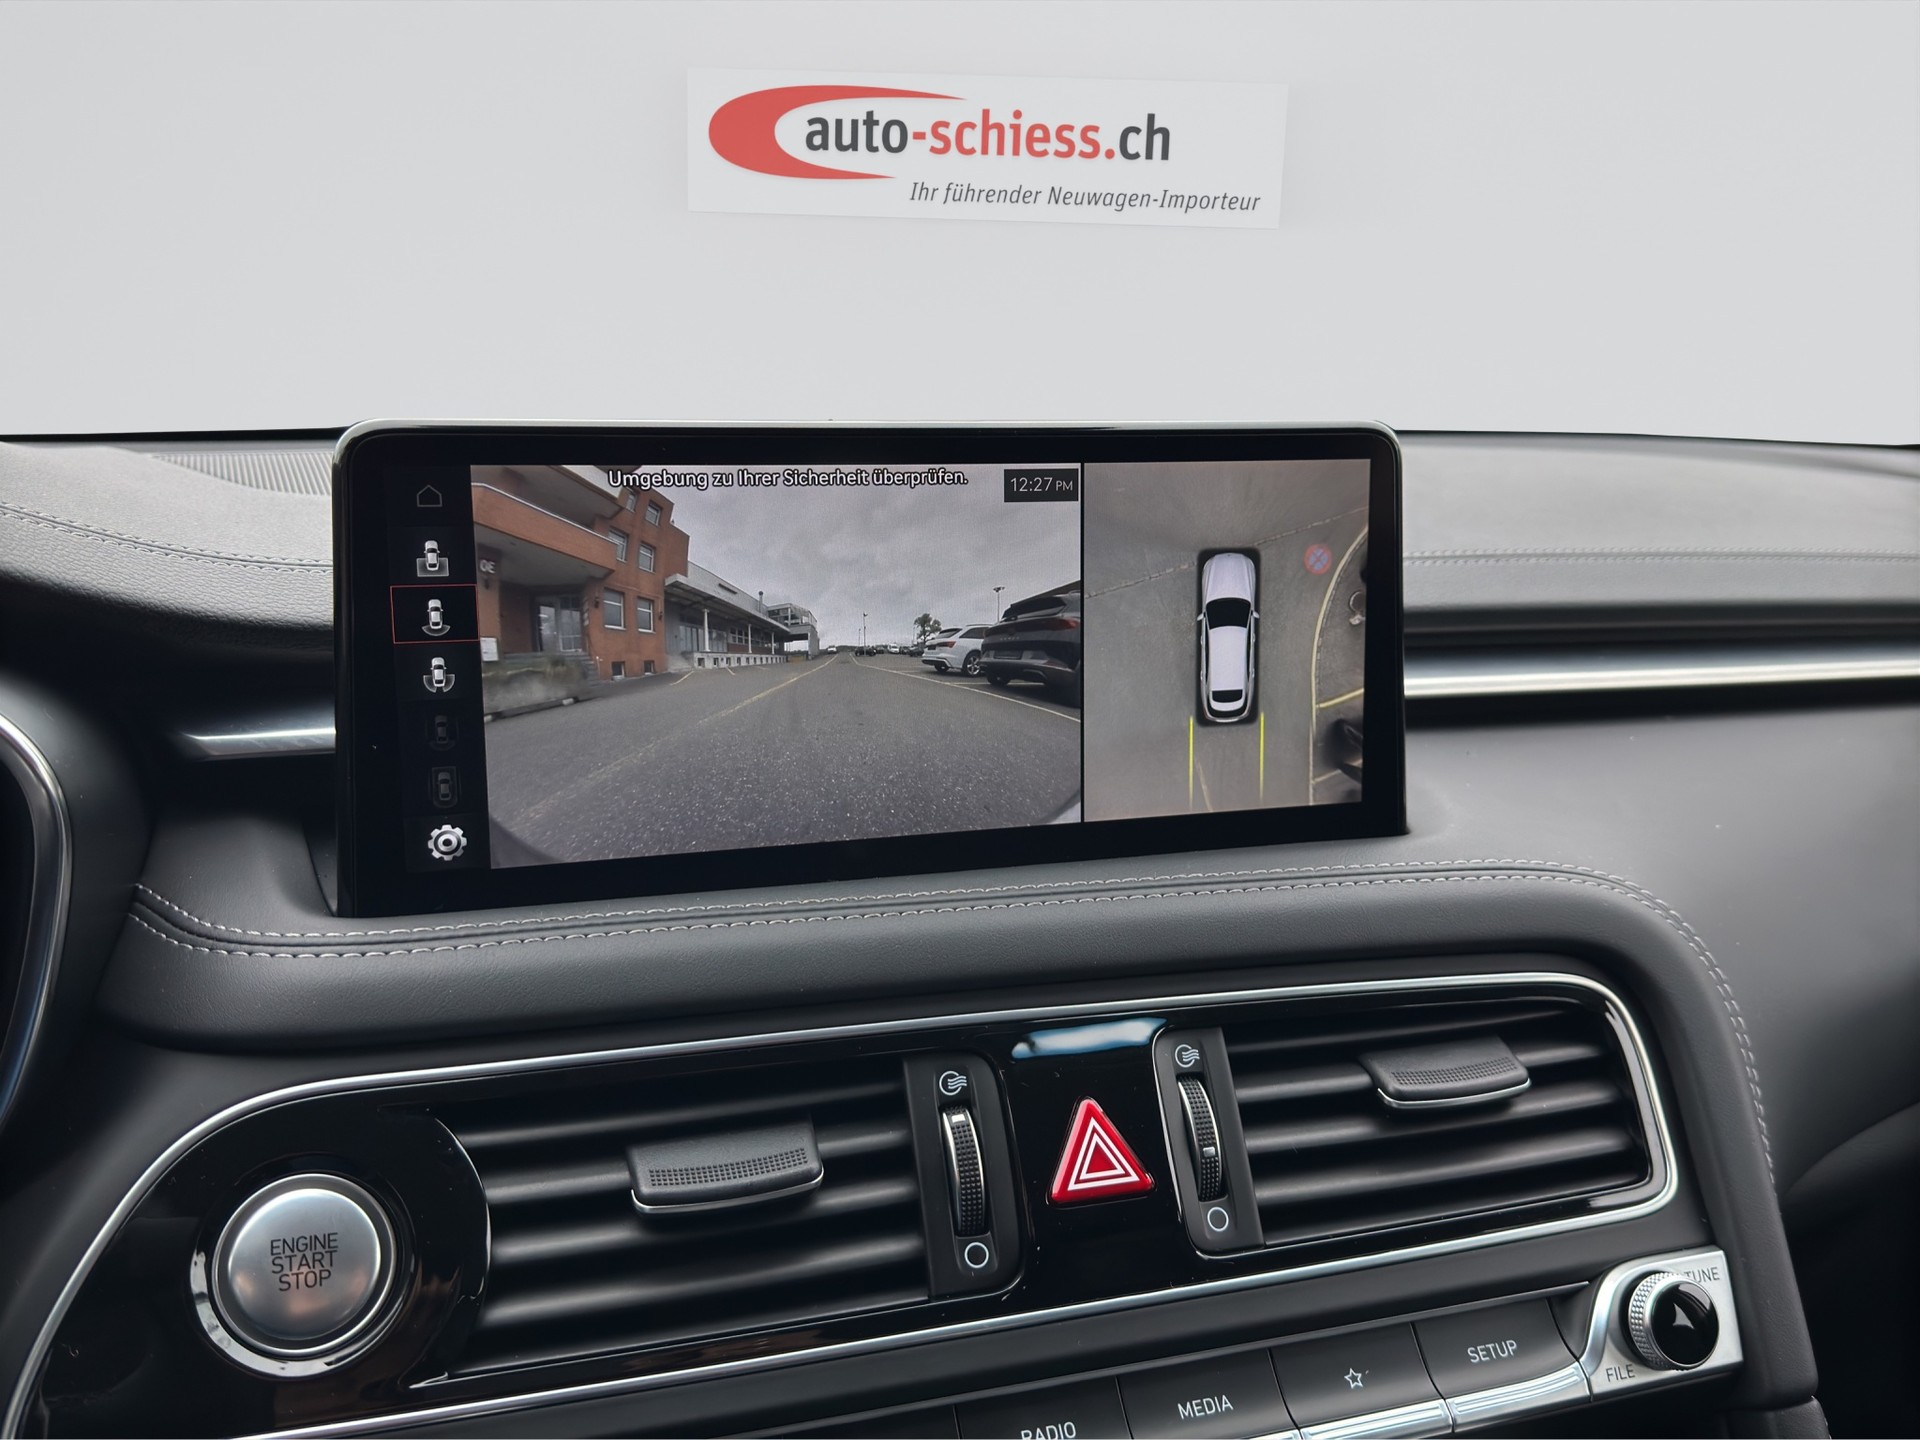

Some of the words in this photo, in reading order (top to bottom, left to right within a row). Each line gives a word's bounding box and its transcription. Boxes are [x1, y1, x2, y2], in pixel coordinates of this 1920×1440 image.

[805, 109, 1170, 161] auto-schiess.ch
[910, 182, 939, 201] Ihr
[943, 182, 1042, 205] führender
[1047, 186, 1261, 213] Neuwagen-Importeur
[609, 469, 708, 490] Umgebung
[712, 473, 733, 487] zu
[738, 469, 780, 487] Ihrer
[783, 468, 868, 486] Sicherheit
[873, 467, 968, 489] überprüfen.
[1010, 477, 1053, 493] 12:27
[1055, 481, 1074, 491] PM
[270, 1232, 339, 1256] ENGINE
[271, 1249, 338, 1274] START
[278, 1269, 332, 1292] STOP
[1683, 1266, 1720, 1284] TUNE
[1467, 1339, 1517, 1363] SETUP
[1605, 1364, 1636, 1382] FILE
[1177, 1394, 1234, 1420] MEDIA
[1021, 1421, 1076, 1440] RADIO
